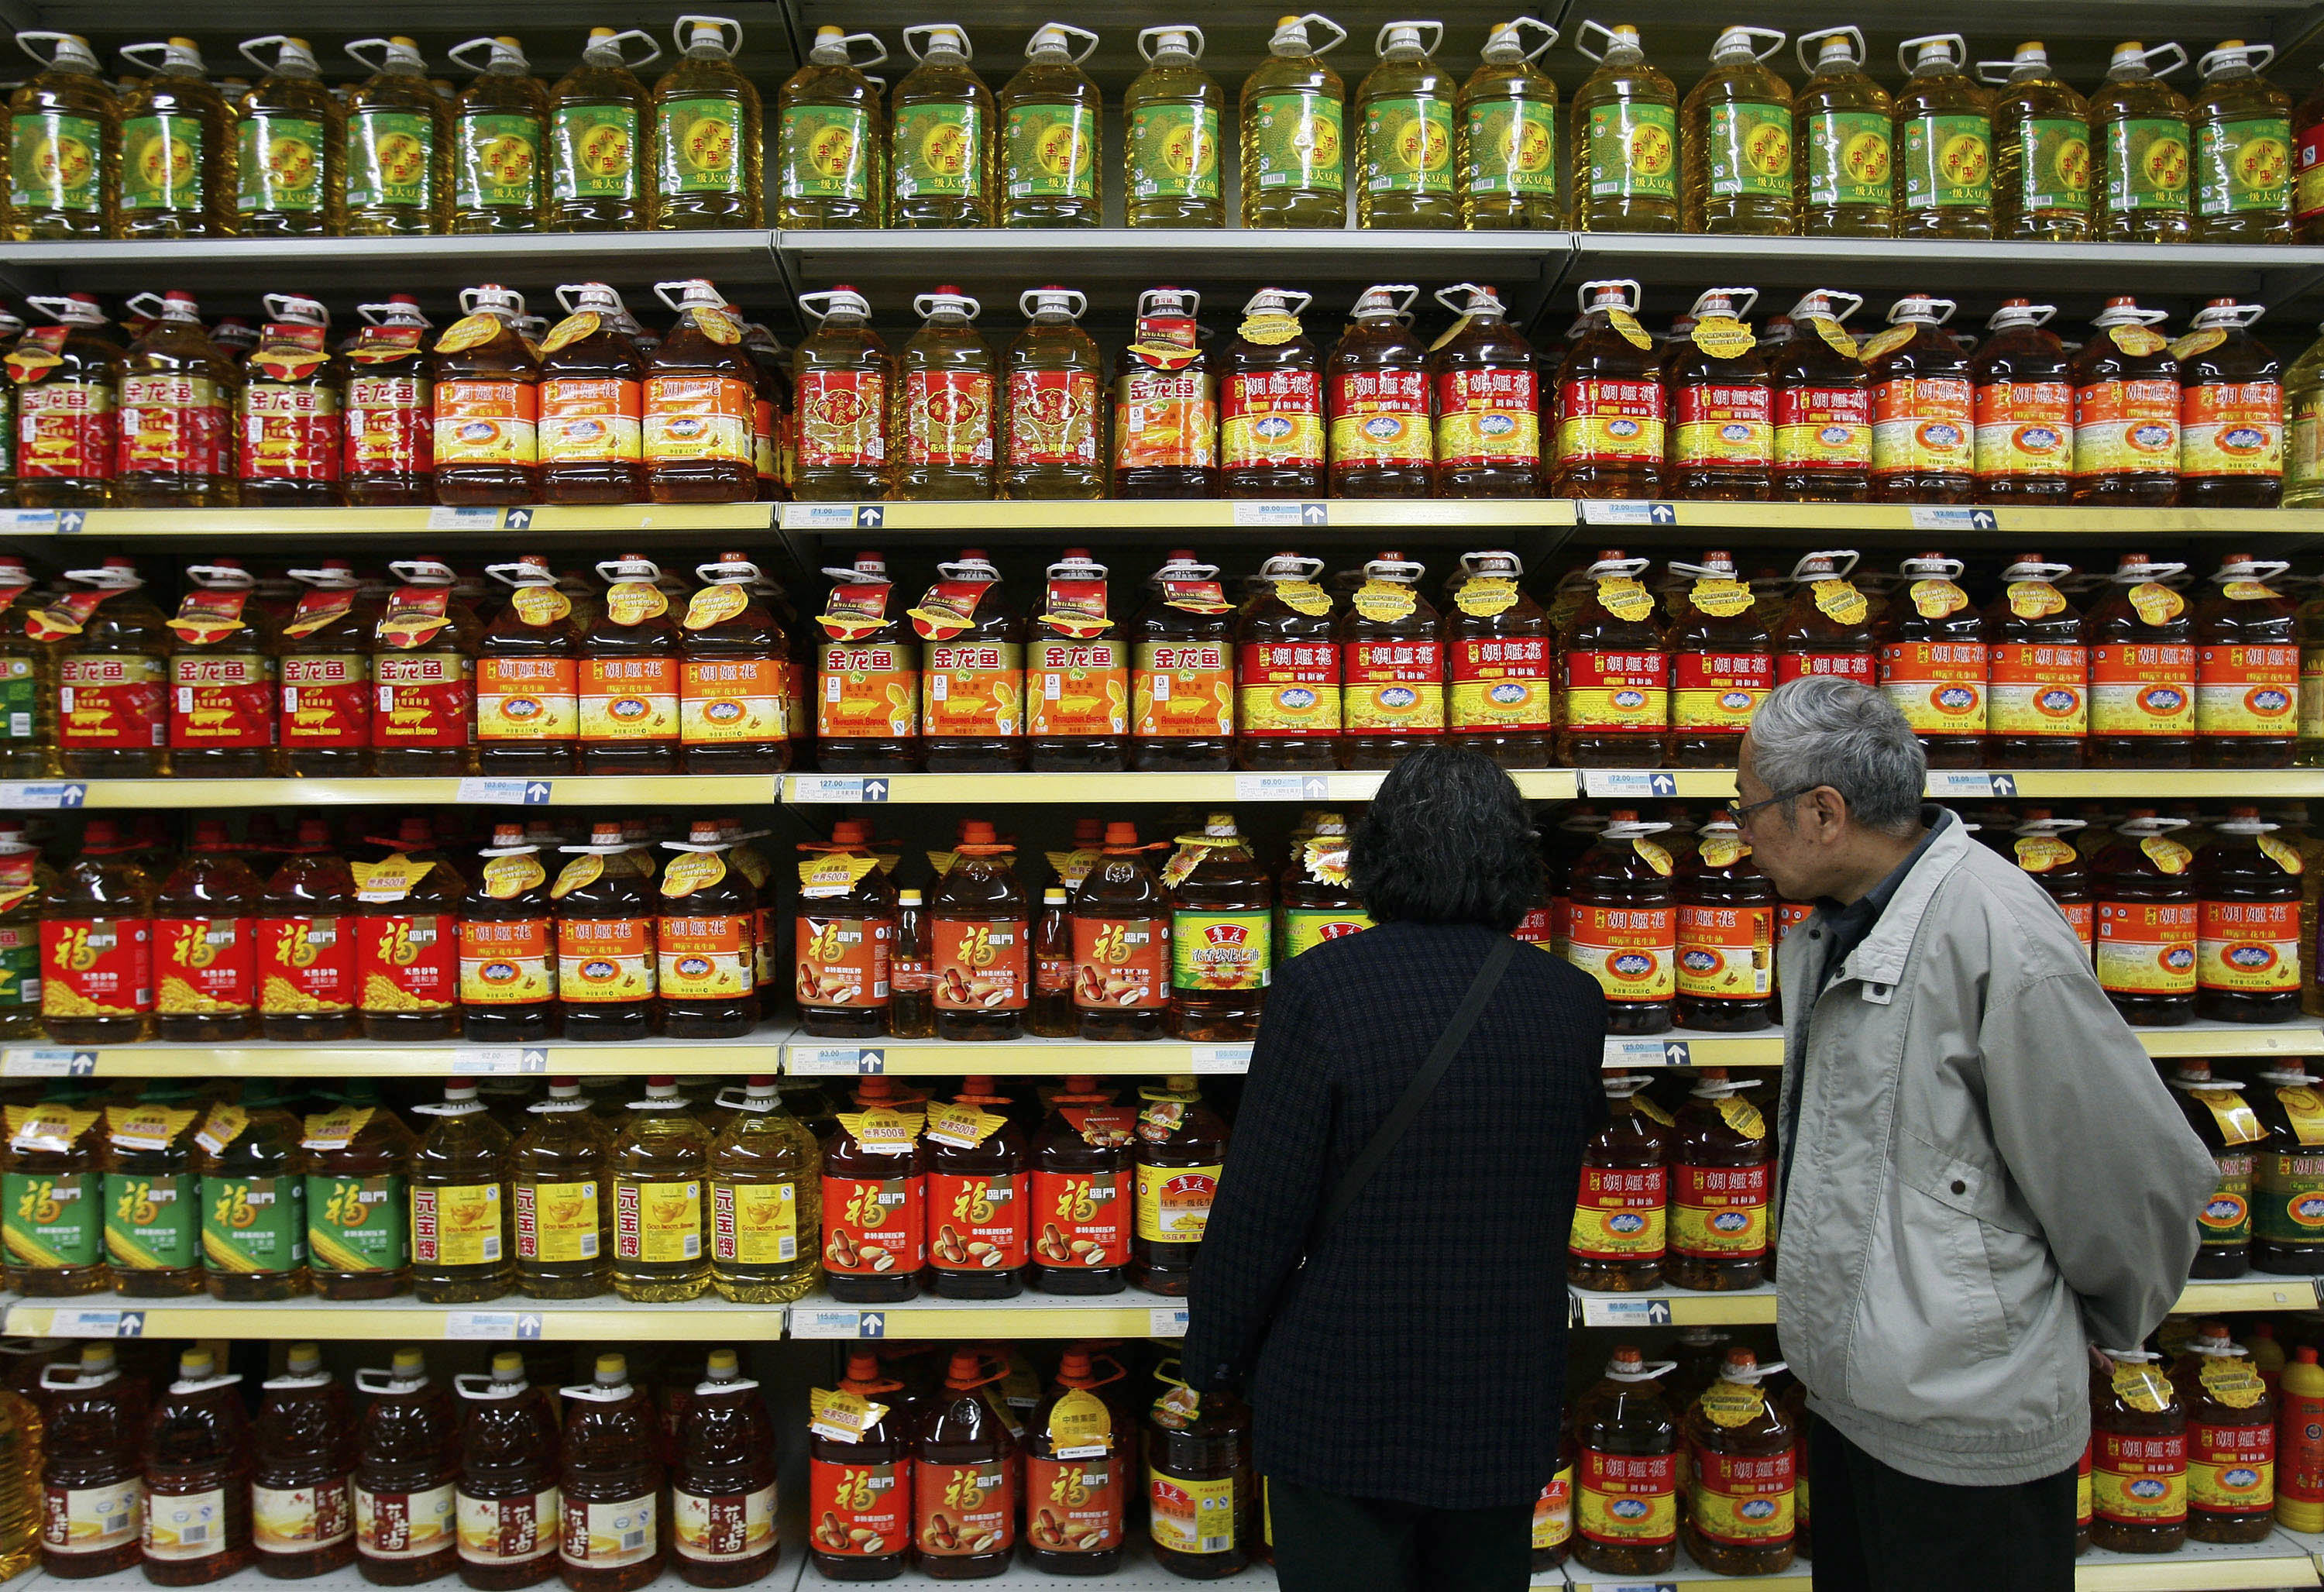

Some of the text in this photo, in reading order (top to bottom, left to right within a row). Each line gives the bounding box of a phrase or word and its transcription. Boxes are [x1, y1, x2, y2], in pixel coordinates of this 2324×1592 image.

[1129, 378, 1195, 401] 金龙鱼
[250, 390, 316, 411] 金龙鱼
[1260, 504, 1281, 513] 80.00
[827, 649, 893, 671] 金龙鱼
[934, 648, 1000, 670] 金龙鱼
[1047, 646, 1113, 669] 金龙鱼
[1154, 648, 1222, 670] 金龙鱼
[1273, 648, 1333, 665] 胡姬花
[1373, 648, 1434, 665] 胡姬花
[1483, 643, 1543, 662] 胡姬花
[62, 661, 124, 682] 金龙鱼
[178, 660, 247, 682] 金龙鱼
[284, 660, 347, 682] 金龙鱼
[380, 660, 445, 680] 金龙鱼
[498, 661, 555, 679] 胡姬花
[606, 662, 663, 679] 胡姬花
[701, 664, 758, 680] 胡姬花
[1607, 656, 1661, 672] 胡姬花
[1714, 658, 1769, 673] 胡姬花
[1815, 658, 1869, 673] 胡姬花
[974, 717, 995, 726] BRAND
[819, 779, 844, 788] 127.00
[1611, 775, 1631, 783] 72.00
[812, 872, 851, 882] 世界500强
[1607, 911, 1667, 929] 胡姬花
[1679, 910, 1736, 928] 胡姬花
[2223, 906, 2288, 924] 胡姬花
[475, 924, 532, 940] 胡姬花
[575, 923, 632, 939] 胡姬花
[670, 920, 727, 935] 胡姬花
[1633, 936, 1658, 945] 花生油
[1699, 935, 1724, 944] 花生油
[819, 1050, 840, 1058] 93.00
[864, 1127, 907, 1139] 世界500强
[938, 1119, 981, 1137] 世界500强
[1603, 1172, 1662, 1191] 胡姬花
[1707, 1171, 1764, 1190] 胡姬花
[415, 1190, 438, 1262] 元宝牌
[516, 1187, 538, 1258] 元宝牌
[619, 1187, 641, 1259] 元宝牌
[715, 1188, 737, 1260] 元宝牌
[720, 1504, 747, 1552] 花生油
